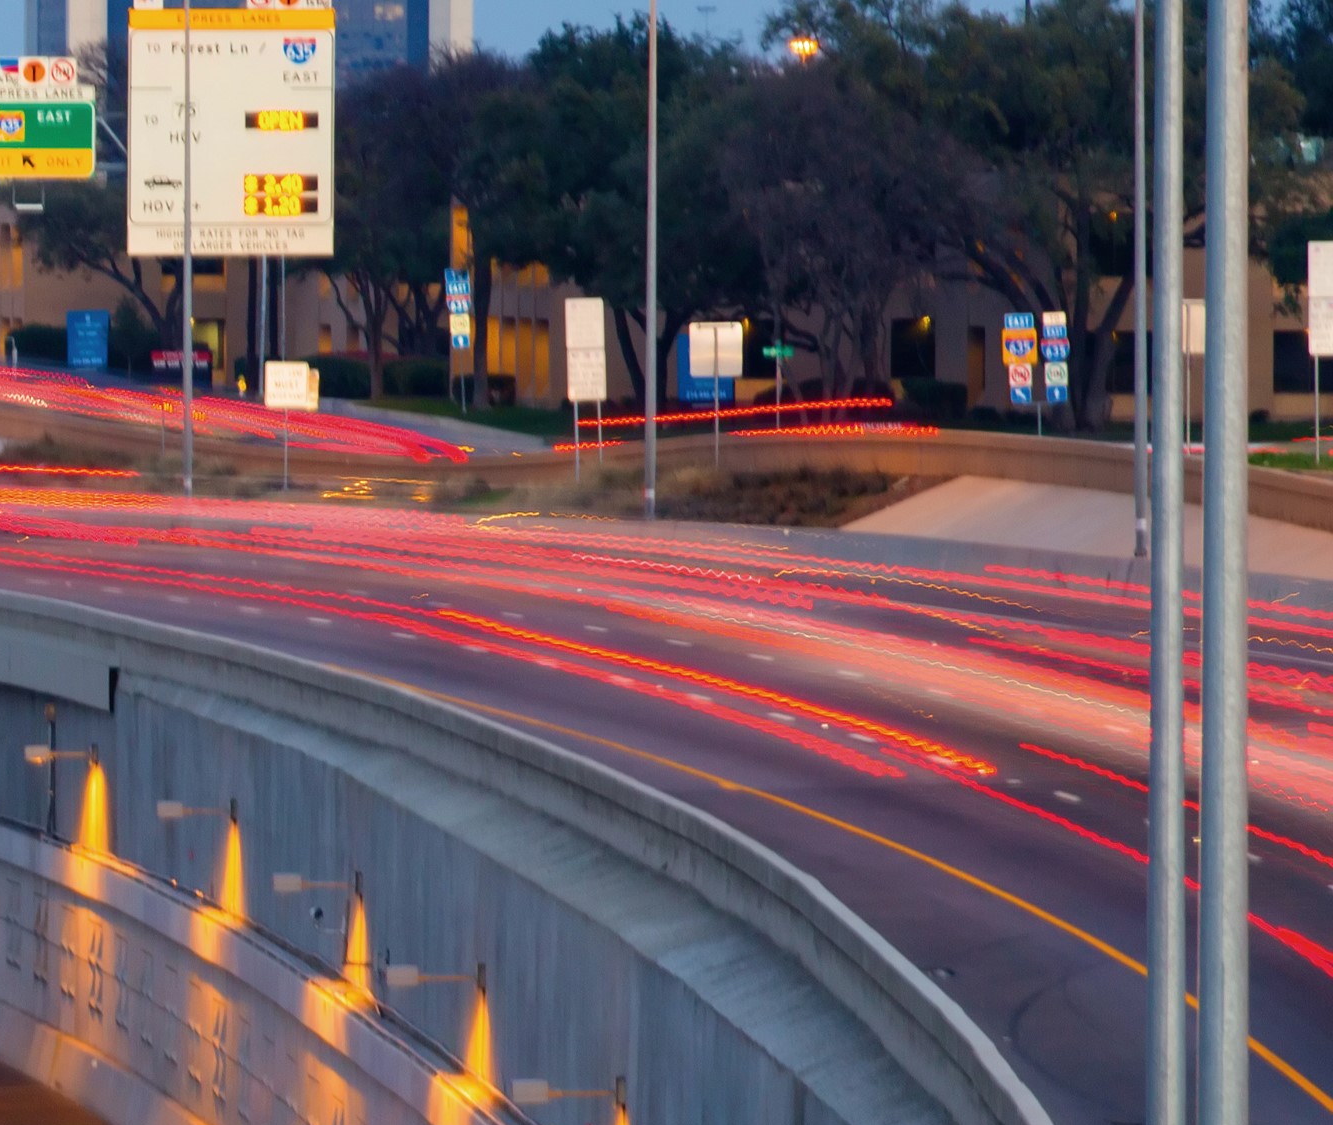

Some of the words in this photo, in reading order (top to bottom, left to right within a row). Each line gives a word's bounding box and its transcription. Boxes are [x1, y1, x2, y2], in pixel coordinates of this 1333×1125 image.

[176, 14, 232, 24] EPRESS
[229, 43, 249, 54] Ln
[286, 43, 314, 62] 635
[282, 71, 319, 83] EAST
[45, 88, 83, 99] LANES
[36, 109, 71, 123] EAST
[258, 110, 305, 131] OPEN
[46, 155, 82, 167] ONLY
[264, 173, 304, 195] 2.40
[143, 200, 175, 213] HOV
[264, 195, 302, 216] 1.20
[199, 229, 232, 239] RATES
[238, 229, 258, 239] FOR
[265, 229, 279, 238] NO
[286, 228, 305, 239] TAG
[239, 239, 289, 250] VEHICLES
[1008, 315, 1029, 328] EAST
[1046, 344, 1065, 358] 635
